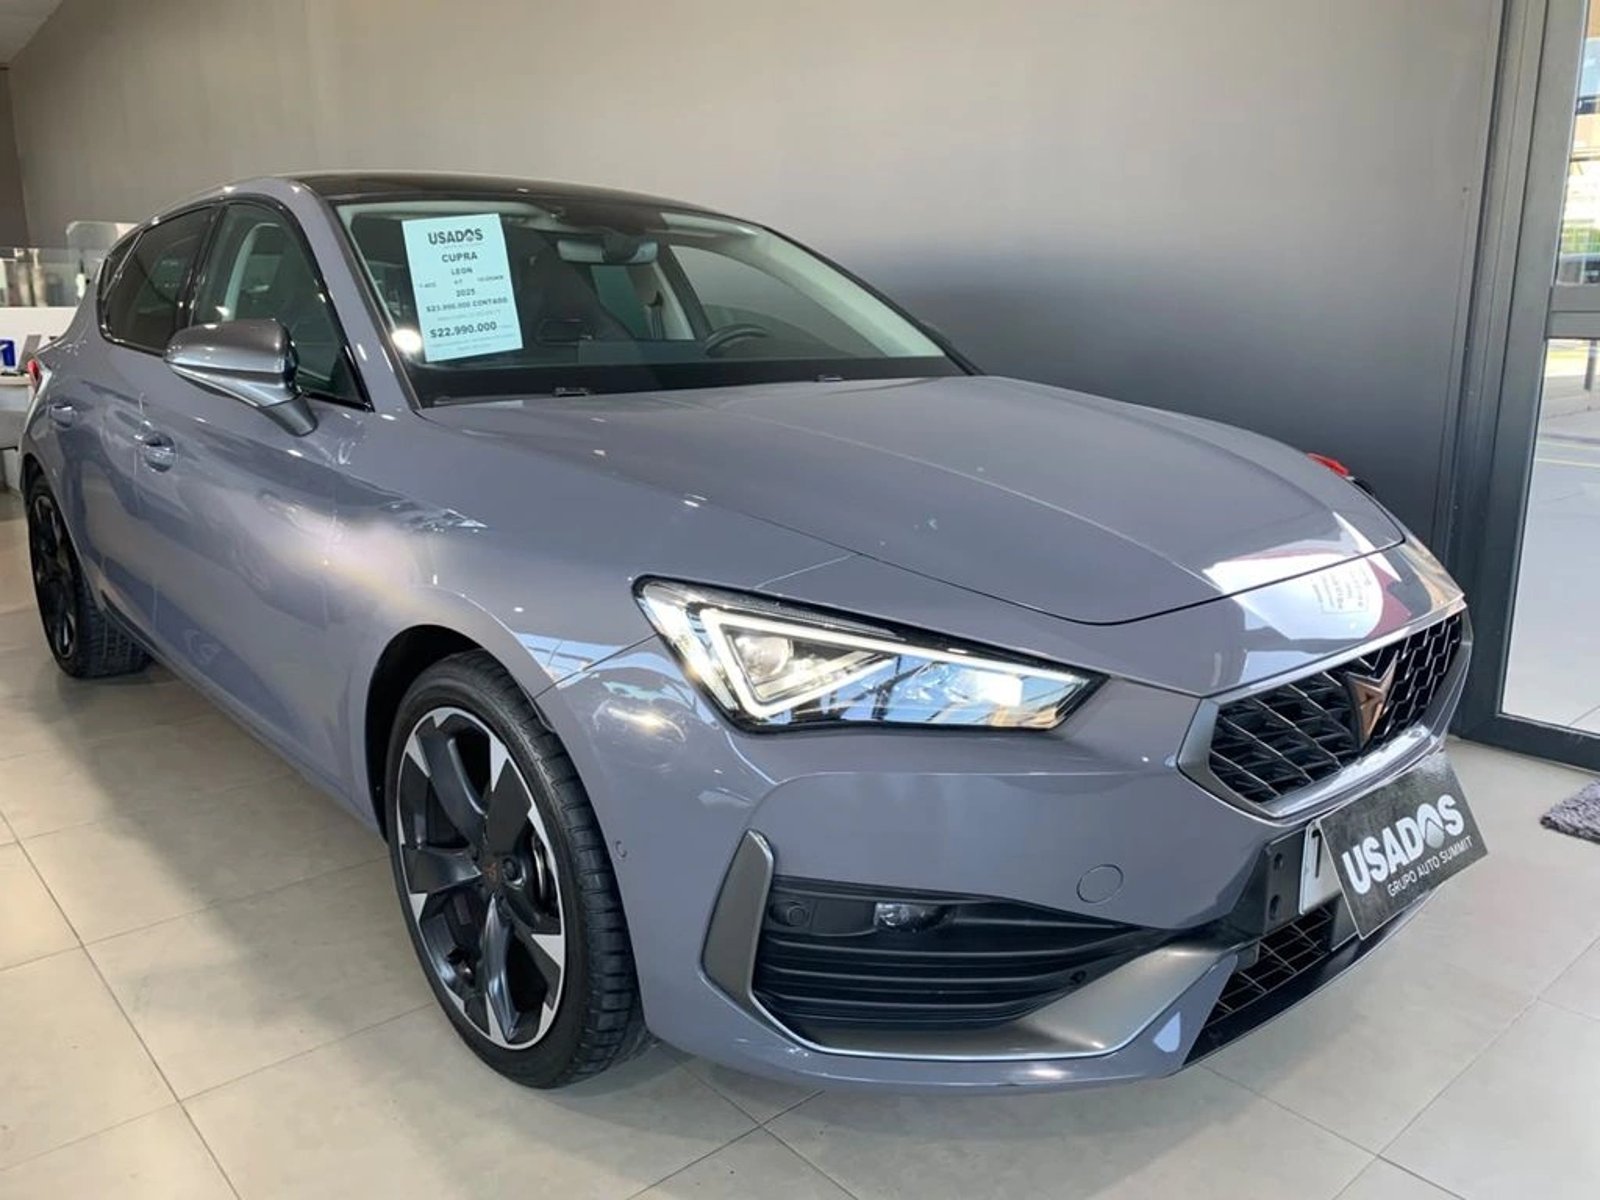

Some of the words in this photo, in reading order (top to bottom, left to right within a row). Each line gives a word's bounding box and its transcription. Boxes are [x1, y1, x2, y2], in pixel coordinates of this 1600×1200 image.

[427, 228, 484, 245] USADOS
[441, 252, 478, 263] CUPRA
[451, 267, 473, 276] LEON
[429, 321, 498, 338] $22.990.000
[1341, 794, 1465, 894] USADOS
[1387, 870, 1418, 897] GRUPO
[1417, 855, 1441, 878] AUTO
[1440, 835, 1474, 864] SUMMIT
